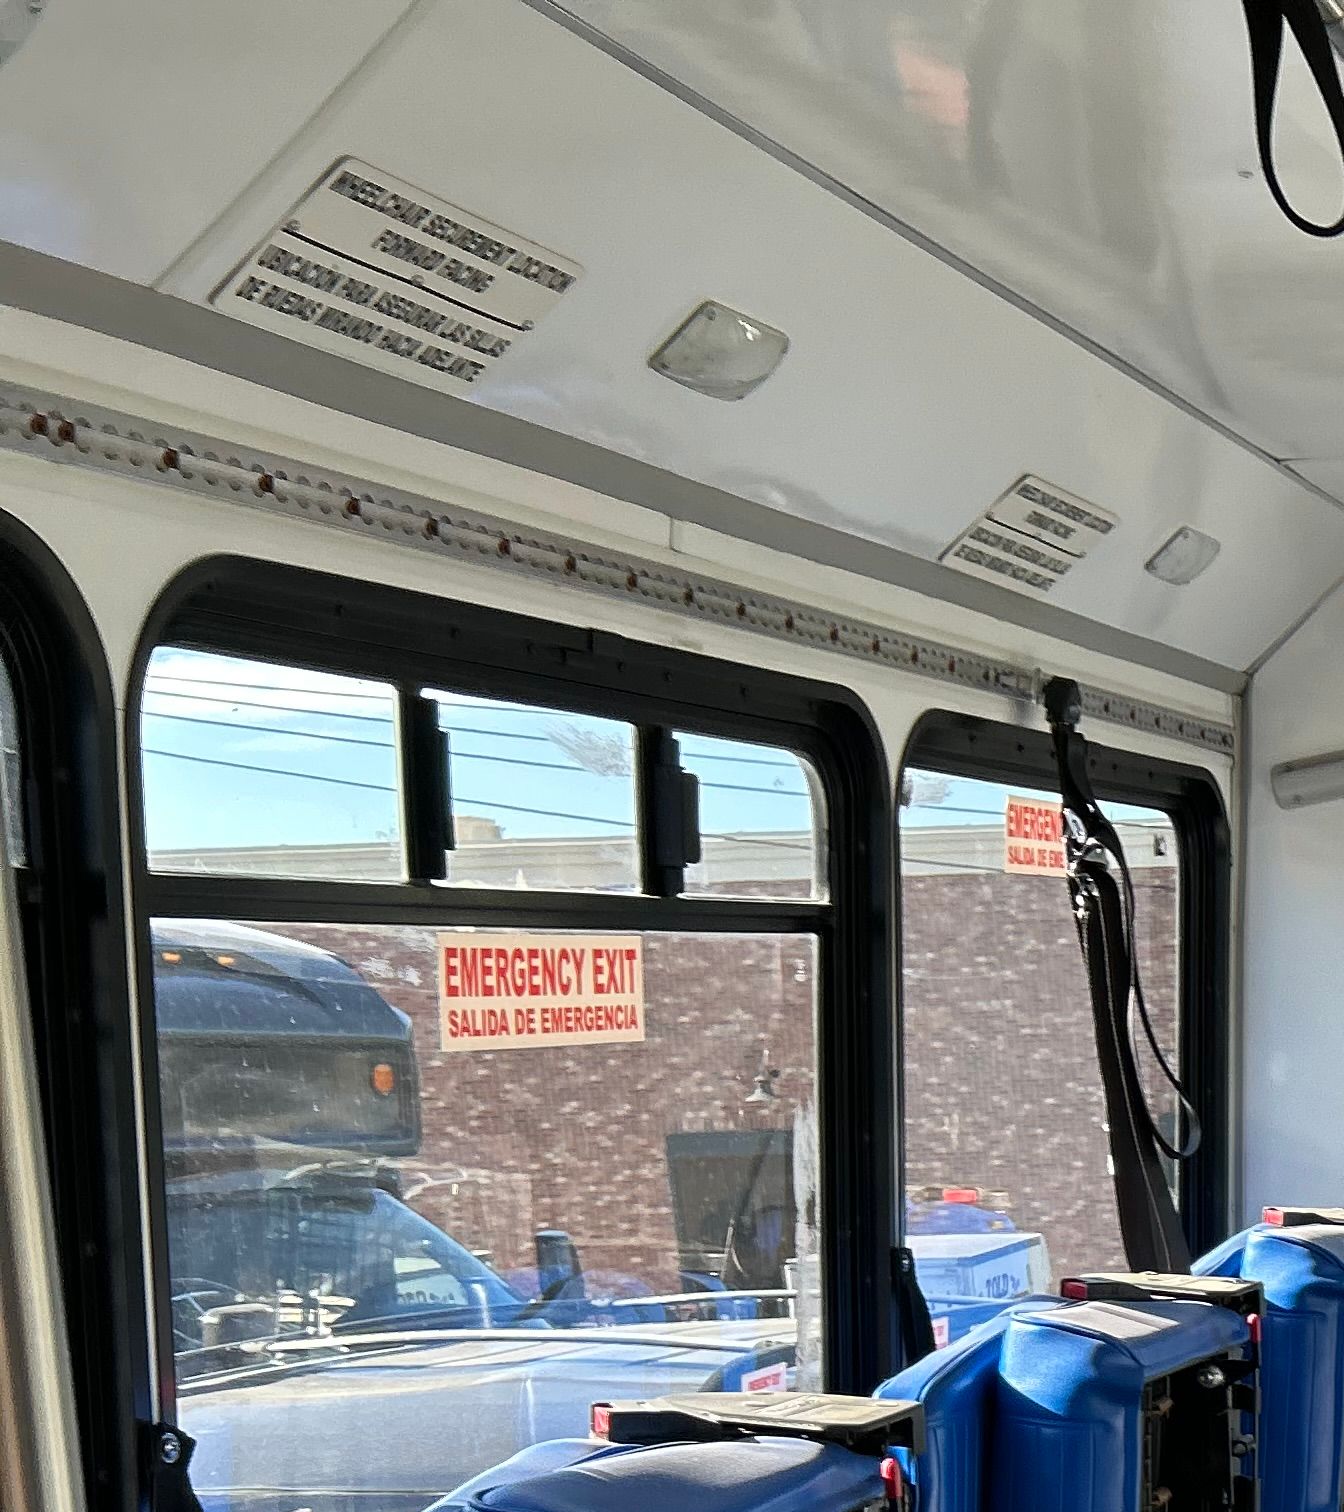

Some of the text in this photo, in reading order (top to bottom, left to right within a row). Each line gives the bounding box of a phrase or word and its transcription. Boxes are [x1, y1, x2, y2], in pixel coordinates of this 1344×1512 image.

[1007, 803, 1063, 844] EMERGEN
[445, 947, 637, 997] EMERGENCY EXIT
[448, 1004, 638, 1038] SALIDA DE EMERGENCIA
